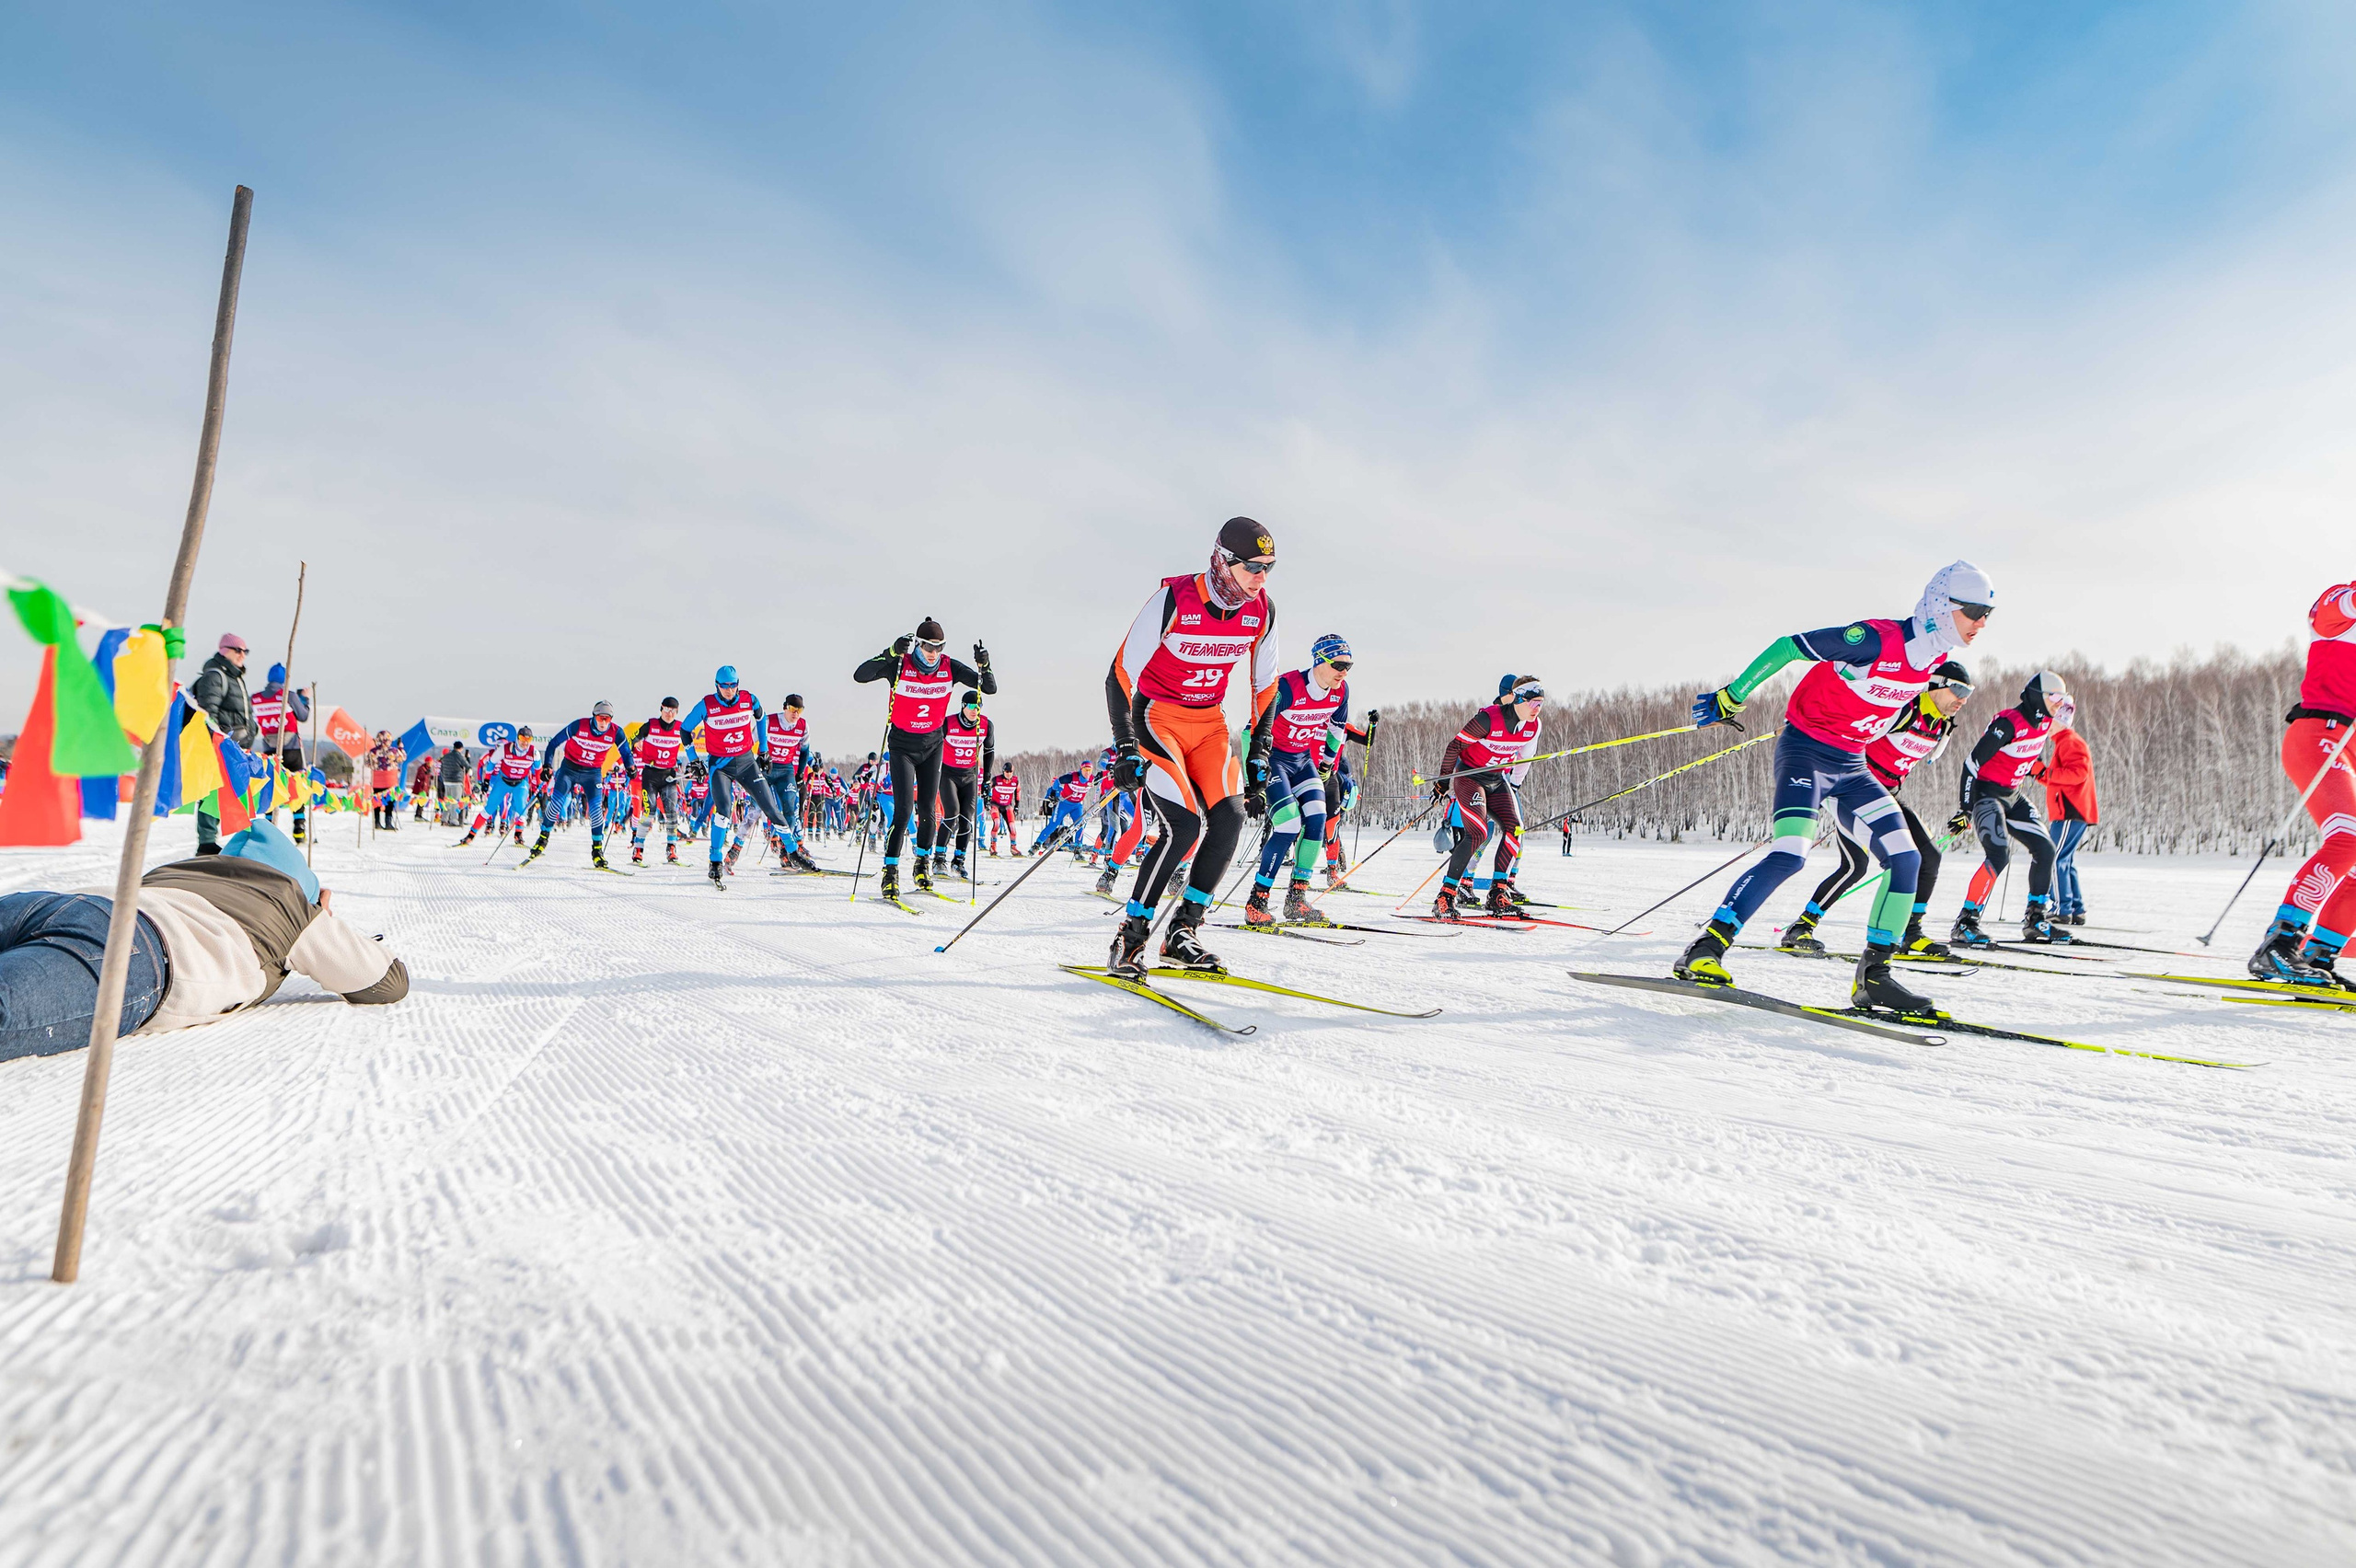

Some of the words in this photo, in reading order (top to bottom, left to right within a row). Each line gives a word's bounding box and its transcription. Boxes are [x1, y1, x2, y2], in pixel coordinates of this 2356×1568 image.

[1182, 668, 1224, 687] 29
[917, 704, 930, 718] 2
[430, 726, 458, 737] Слата
[722, 730, 745, 744] 43
[581, 749, 596, 761] 13
[657, 749, 670, 759] 10
[772, 746, 791, 757] 38
[954, 748, 974, 757] 90
[1183, 971, 1227, 983] FISCHER
[1117, 979, 1140, 992] FISCHER
[2279, 984, 2339, 997] FISCHER
